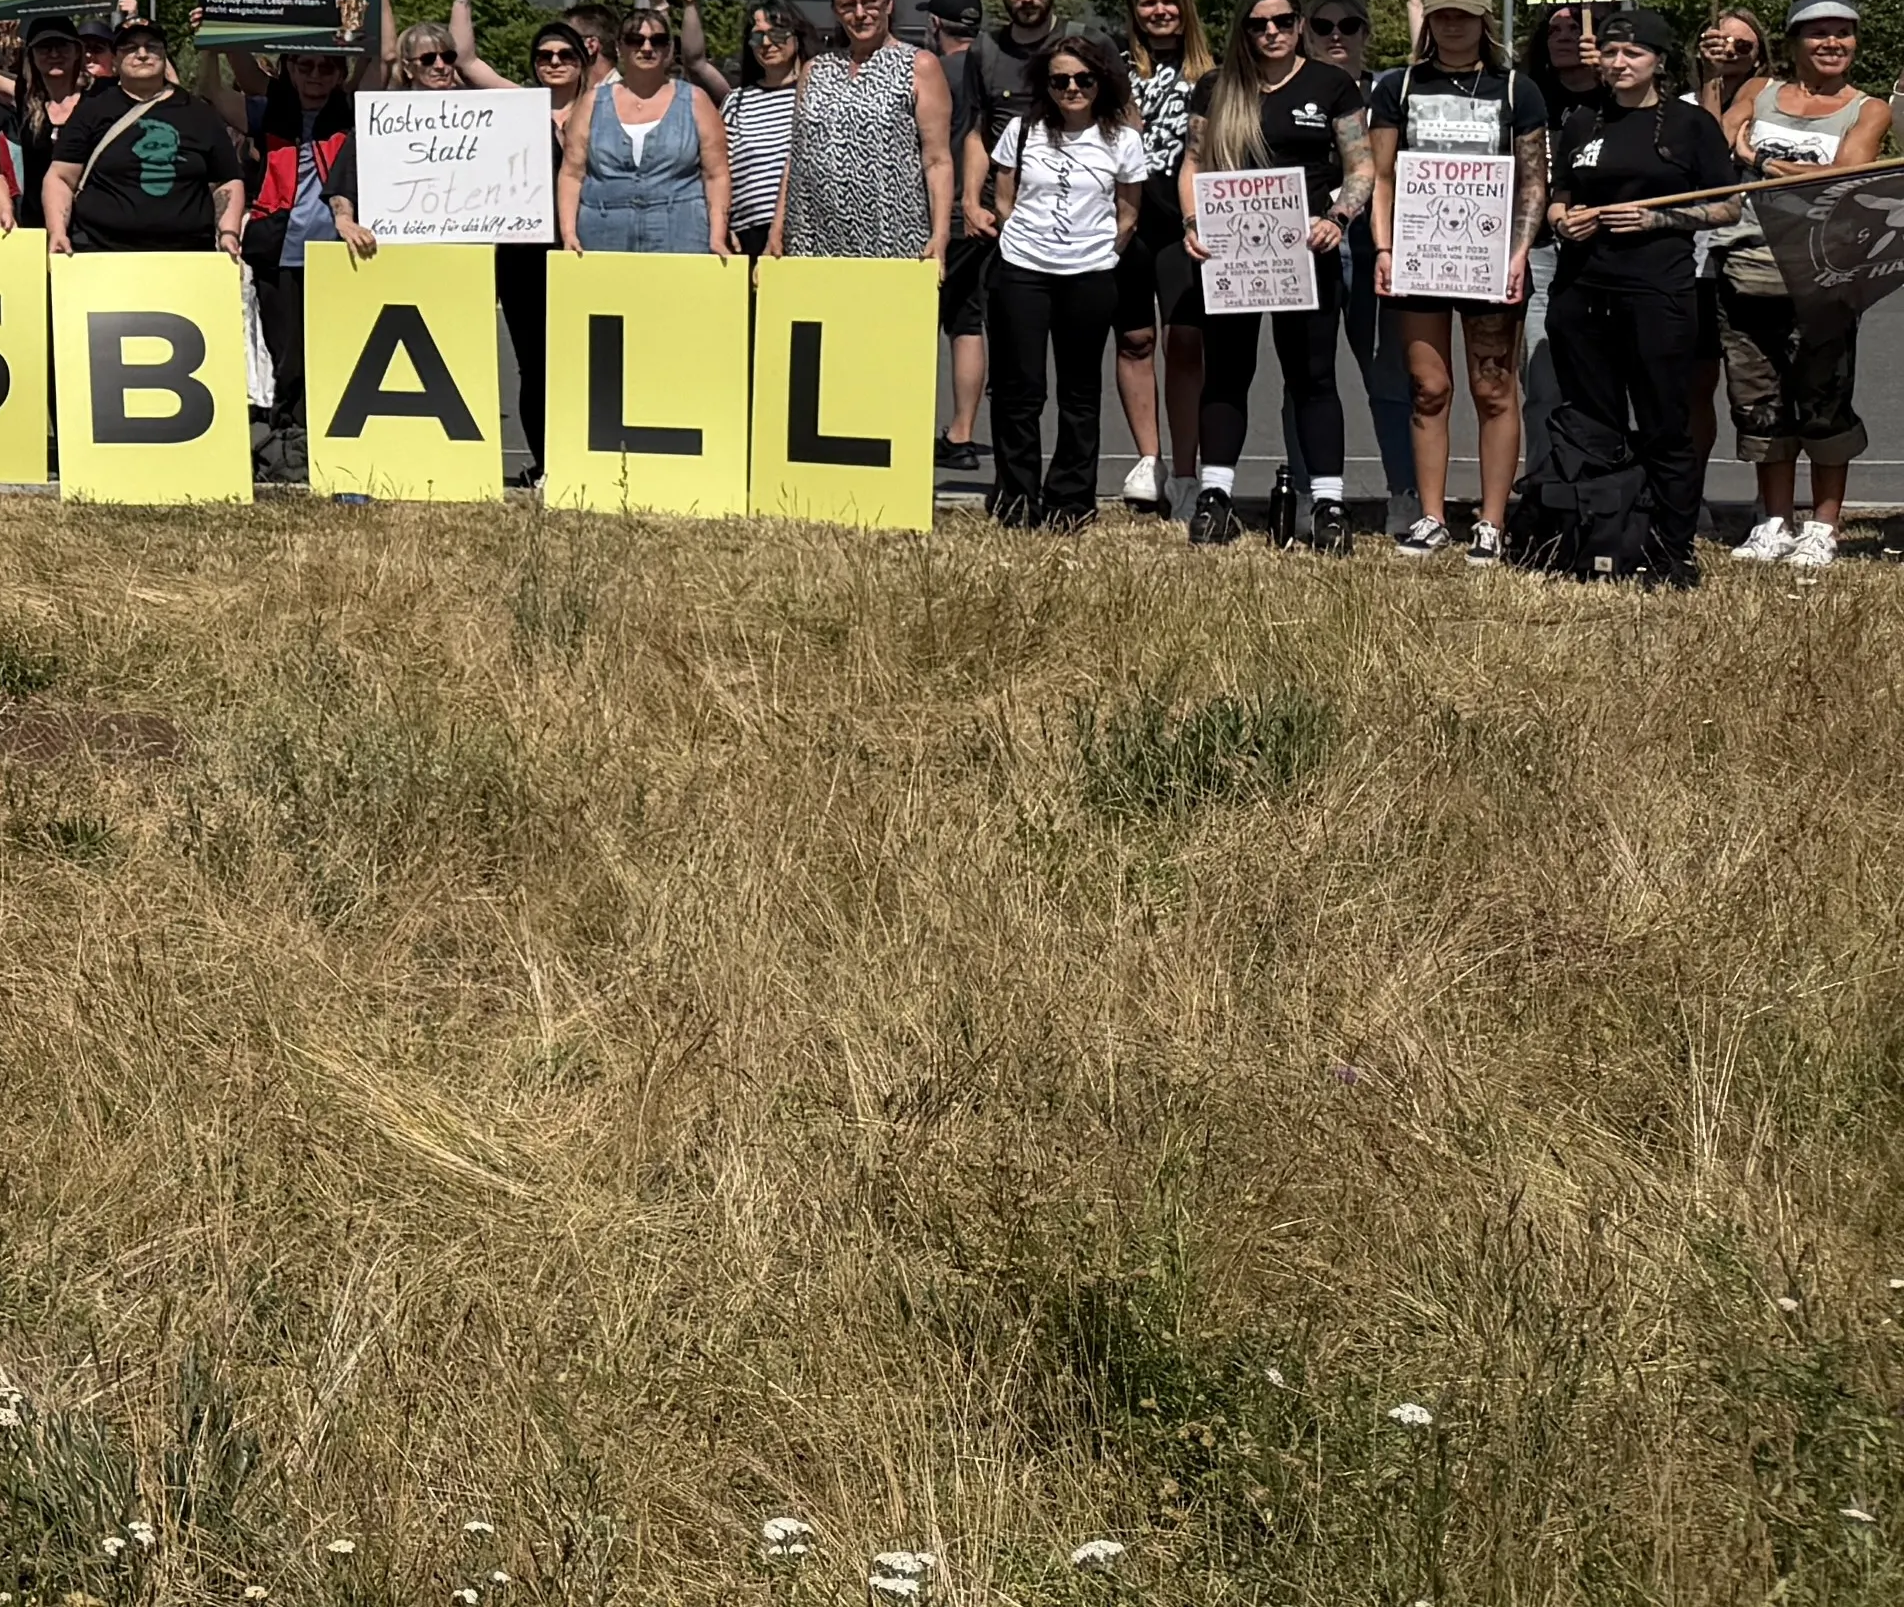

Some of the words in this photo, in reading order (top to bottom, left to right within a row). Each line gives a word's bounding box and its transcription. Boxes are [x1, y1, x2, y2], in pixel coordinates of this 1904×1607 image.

[369, 100, 494, 136] Kastration
[1417, 160, 1496, 181] STOPPT
[1213, 175, 1286, 199] STOPPT
[1407, 182, 1436, 195] DAS
[1205, 202, 1234, 215] DAS
